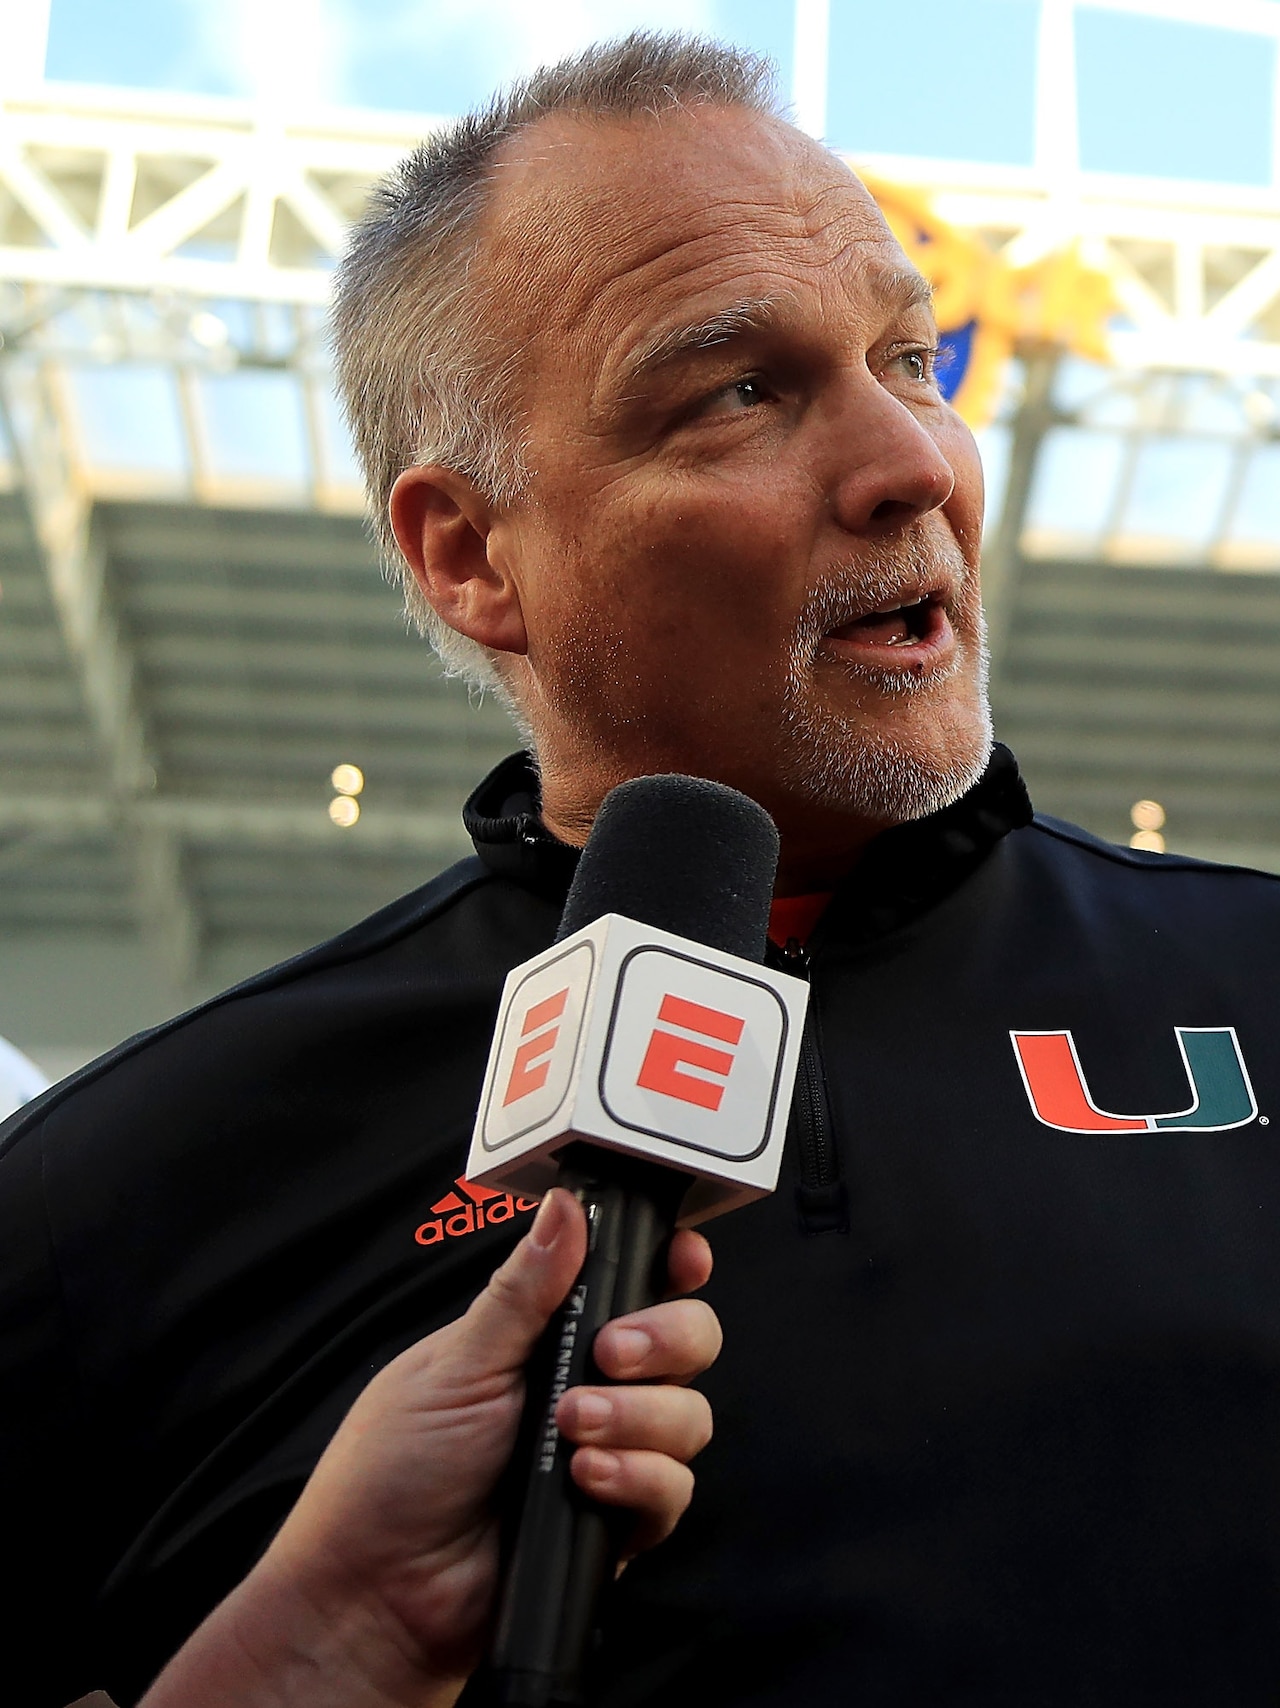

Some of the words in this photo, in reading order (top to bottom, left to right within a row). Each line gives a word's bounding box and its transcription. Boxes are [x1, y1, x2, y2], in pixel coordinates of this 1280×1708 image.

[636, 993, 745, 1111] E
[1009, 1026, 1259, 1134] U
[415, 1192, 539, 1245] adid
